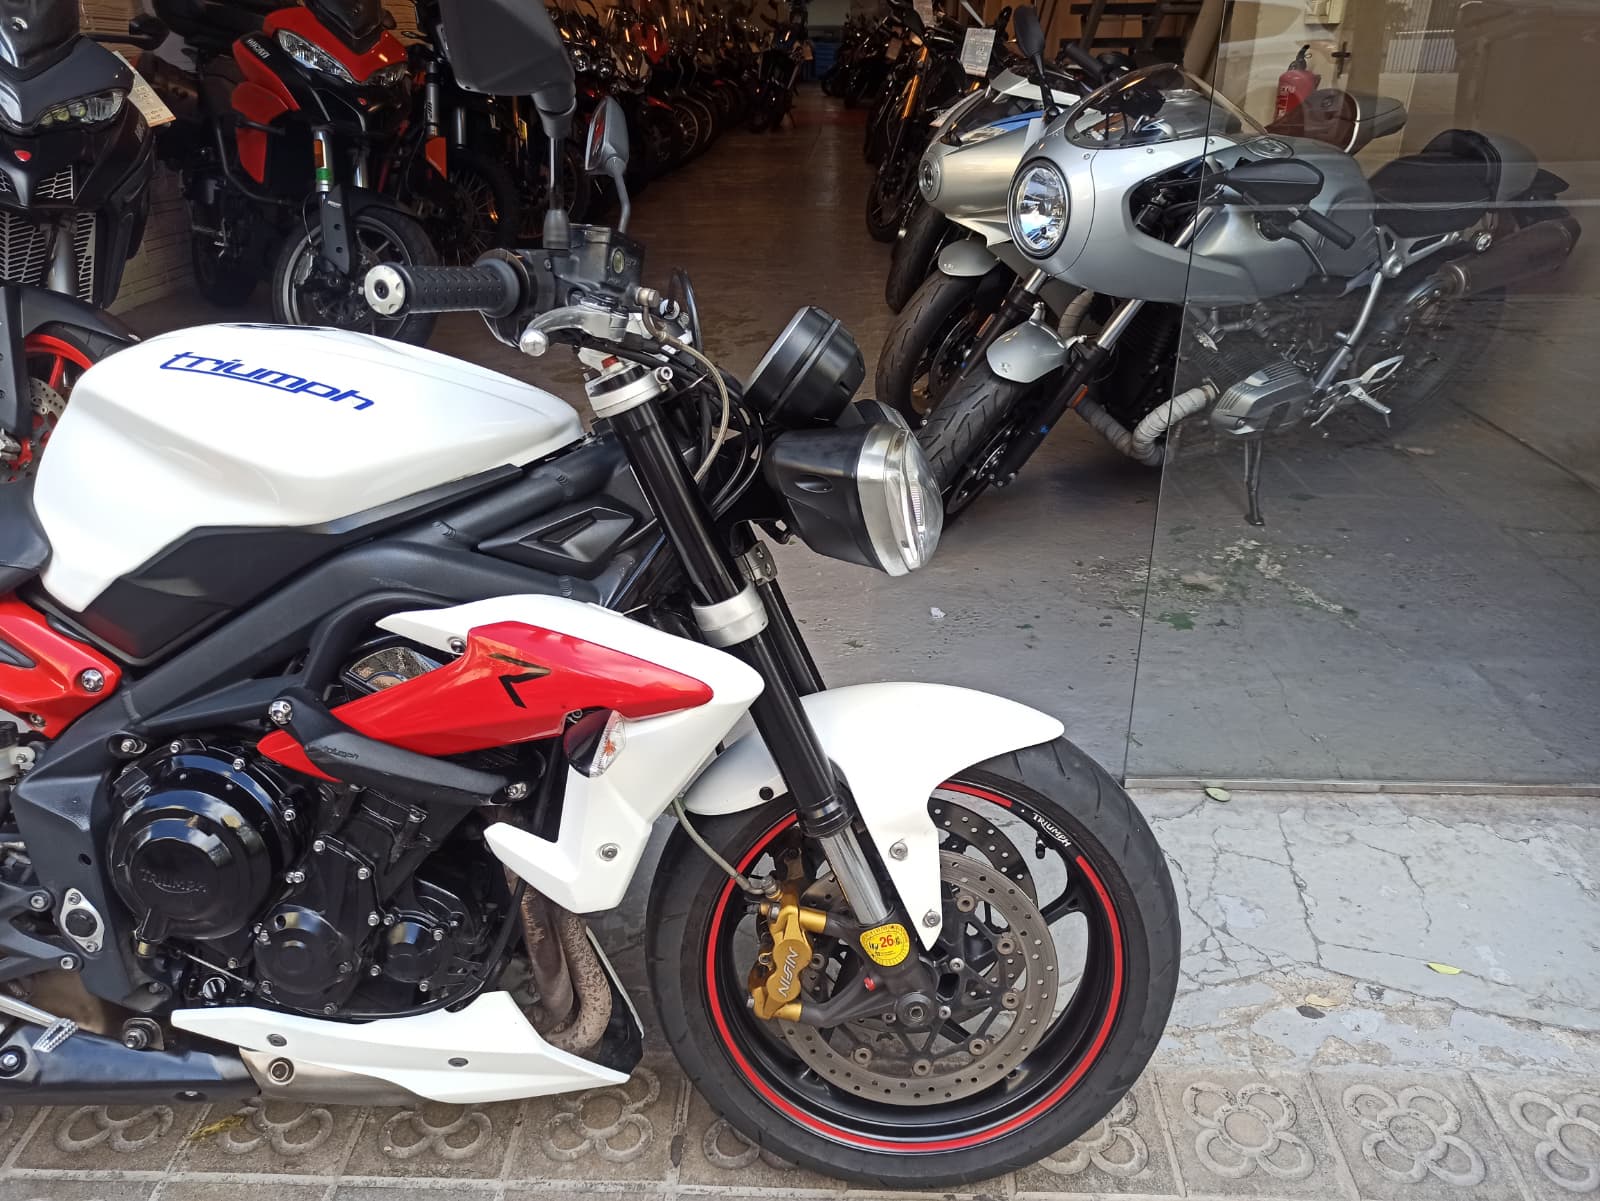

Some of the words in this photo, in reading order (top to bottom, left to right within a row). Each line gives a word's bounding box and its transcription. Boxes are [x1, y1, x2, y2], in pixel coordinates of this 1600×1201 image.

[160, 352, 374, 410] triumph
[1032, 812, 1071, 847] TRIUMPH
[879, 934, 894, 949] 26
[778, 946, 799, 998] NISSIN
